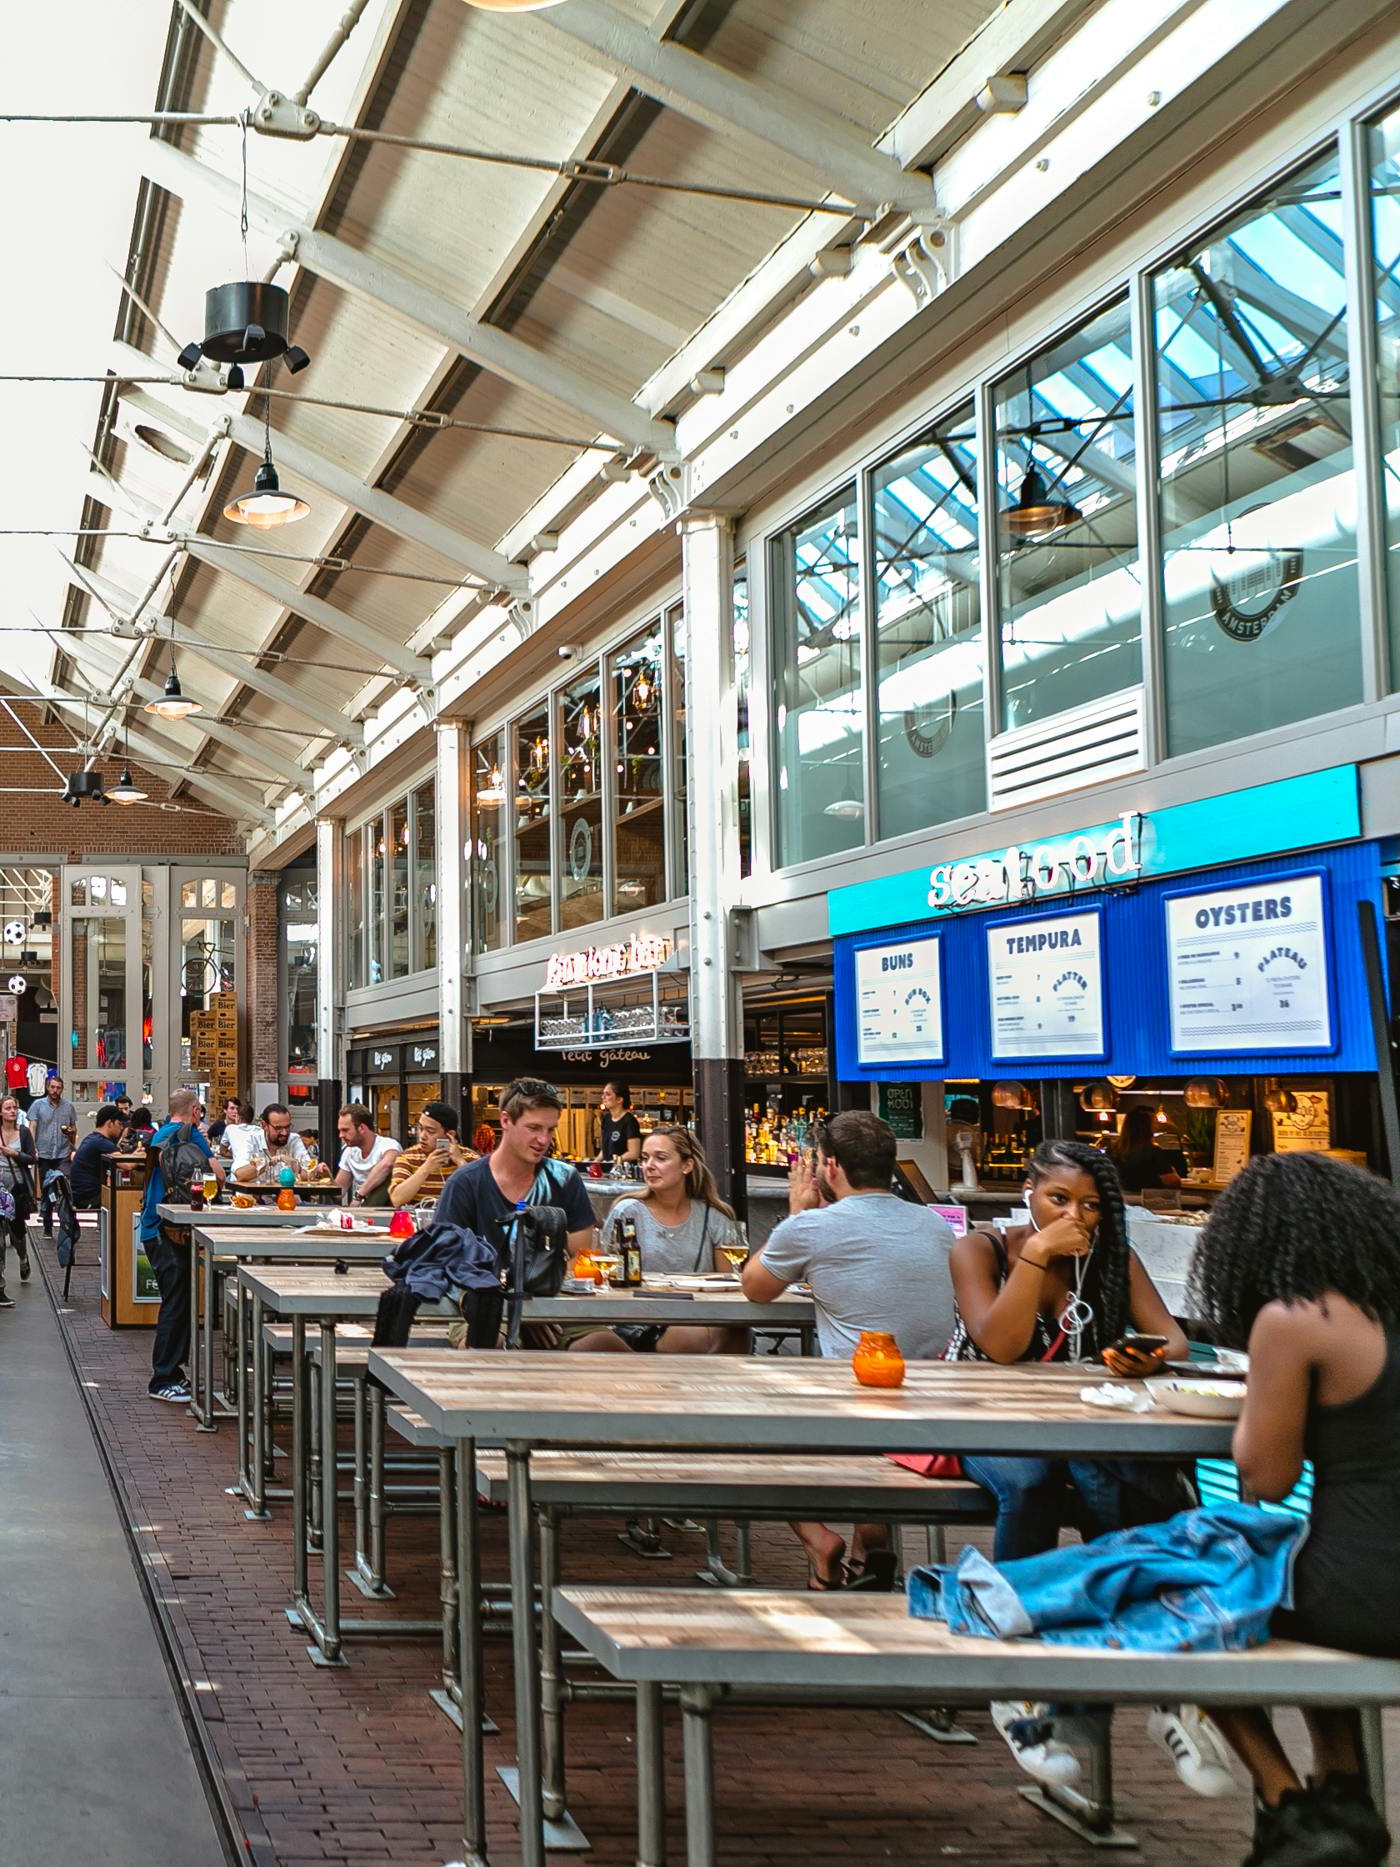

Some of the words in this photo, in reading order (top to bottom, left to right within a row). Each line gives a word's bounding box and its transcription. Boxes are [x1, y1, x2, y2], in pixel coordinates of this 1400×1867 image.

[1195, 896, 1292, 929] OYSTERS
[1006, 928, 1082, 955] TEMPURA
[881, 952, 914, 972] BUNS
[1257, 947, 1308, 973] PLATEAU
[1052, 971, 1088, 992] PLATTER
[218, 1001, 235, 1010] Bier
[218, 1021, 235, 1030] Bier
[198, 1040, 215, 1049] Bier
[218, 1040, 235, 1049] Bier
[218, 1060, 235, 1069] Bier
[600, 1048, 650, 1068] gâteau
[218, 1080, 235, 1088] Bier
